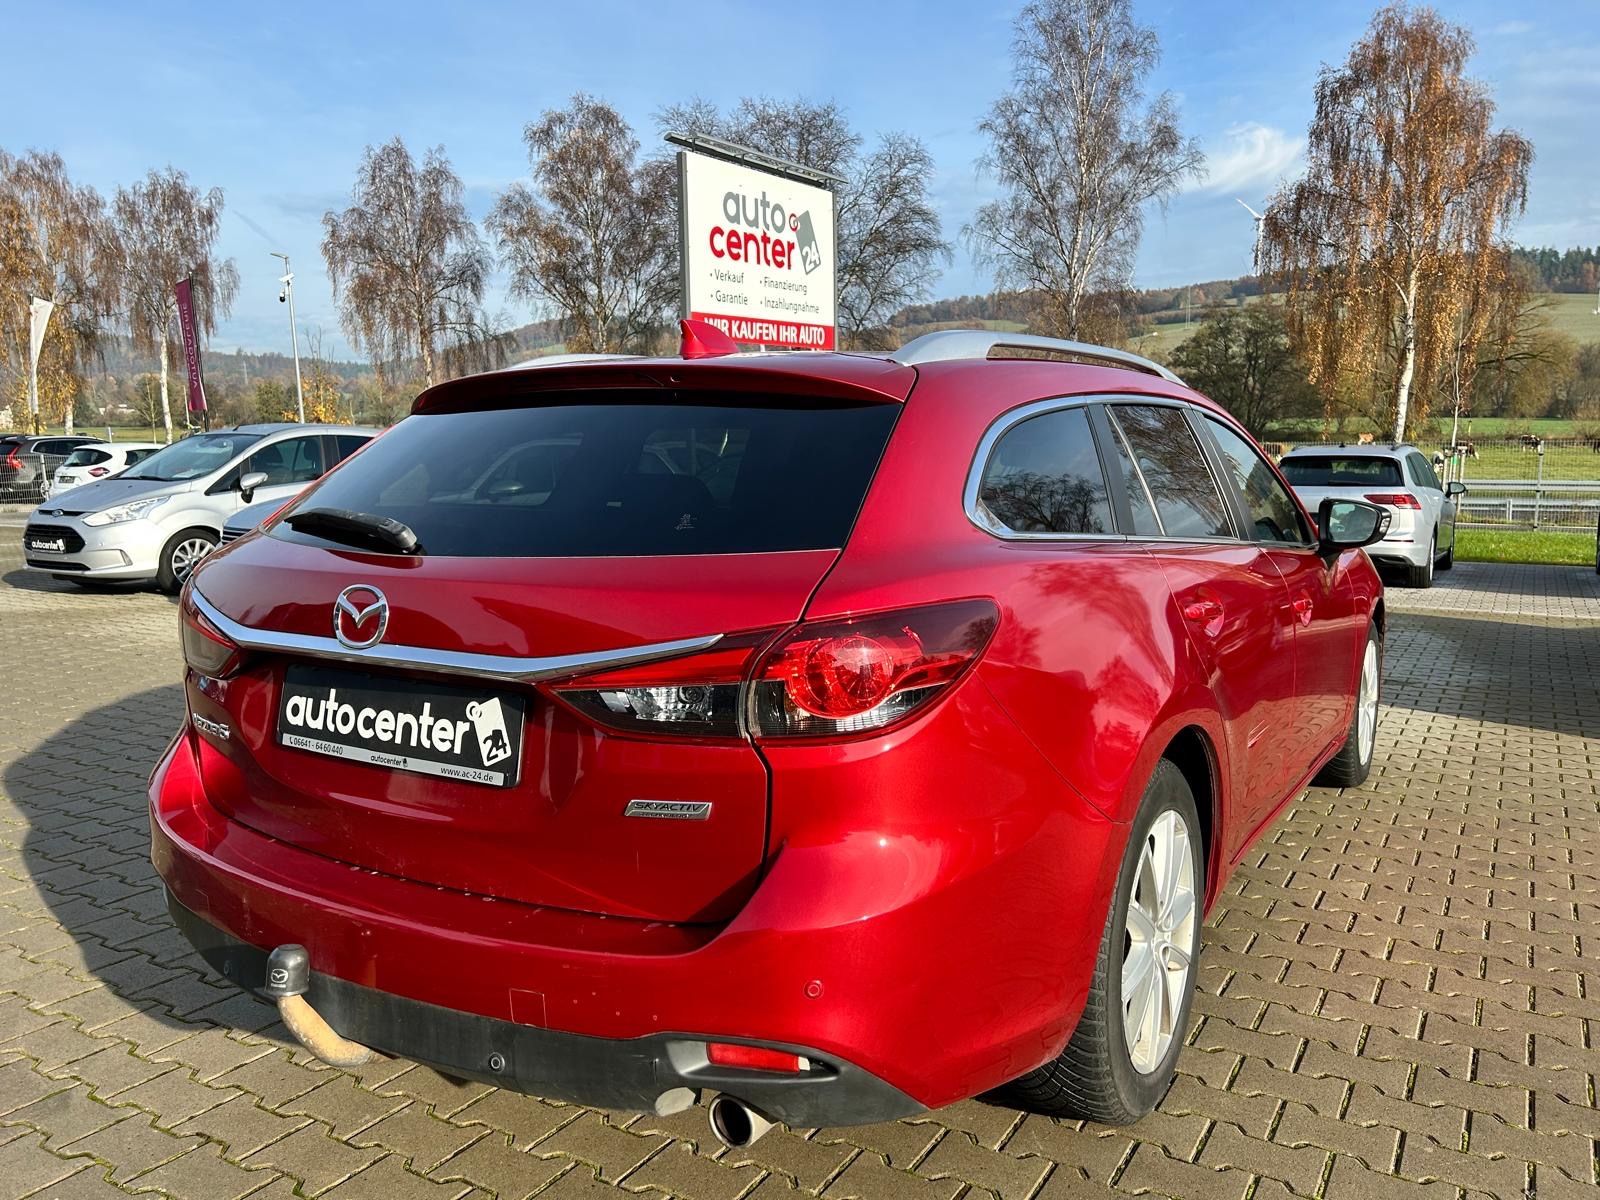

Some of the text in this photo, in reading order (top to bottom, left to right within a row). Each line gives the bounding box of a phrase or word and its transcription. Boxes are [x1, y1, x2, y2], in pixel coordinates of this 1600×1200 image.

[723, 191, 786, 234] auto
[709, 226, 795, 270] center
[802, 240, 820, 272] 24
[714, 268, 745, 284] Verkauf
[764, 276, 808, 295] Finanzierung
[716, 290, 748, 305] Garantie
[764, 296, 820, 314] Inzahlungnahme
[731, 320, 778, 341] KAUFEN
[780, 325, 798, 343] IHR
[799, 326, 826, 345] AUTO
[286, 688, 470, 754] autocenter
[483, 729, 508, 762] 24
[370, 755, 402, 767] autocenter
[440, 766, 494, 783] www.ac-24.de
[634, 801, 701, 812] SKYACTIV
